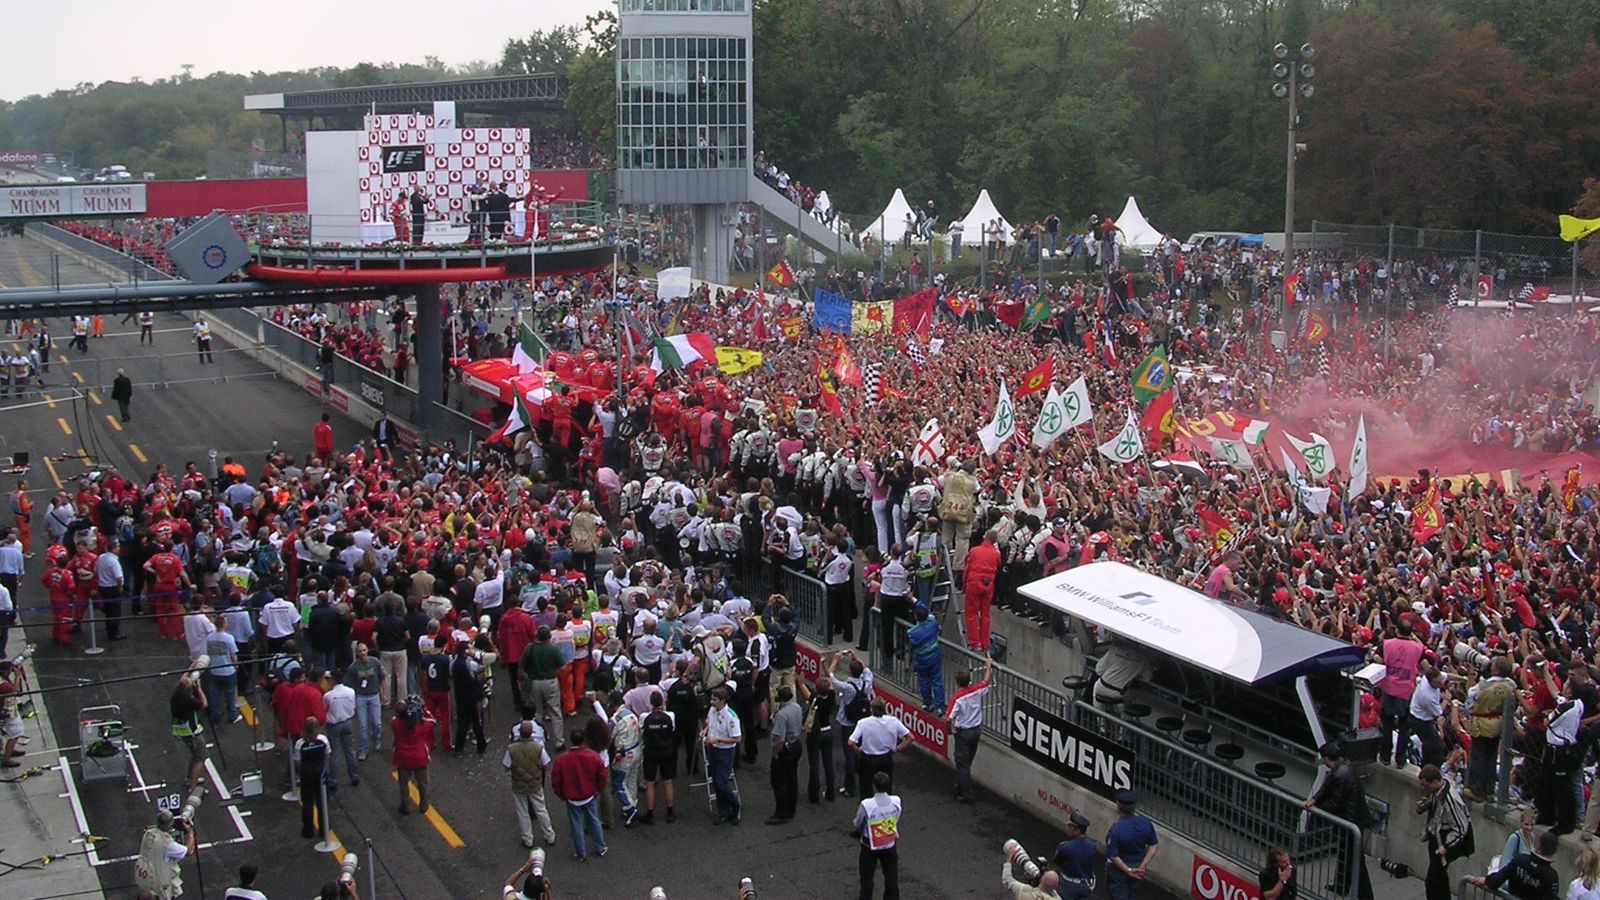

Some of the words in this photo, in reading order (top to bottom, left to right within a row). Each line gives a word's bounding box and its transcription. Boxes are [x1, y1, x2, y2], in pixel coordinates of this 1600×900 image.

[0, 152, 37, 163] dafone
[10, 188, 59, 197] CHAMPAGNE
[83, 187, 131, 196] CHAMPAGNE
[11, 199, 60, 214] MUMM
[84, 197, 132, 212] MUMM
[428, 663, 437, 679] 6
[885, 702, 944, 746] odafone
[1013, 710, 1131, 790] SIEMENS
[1038, 788, 1048, 801] NO
[160, 796, 179, 811] 43
[1221, 880, 1259, 900] vo
